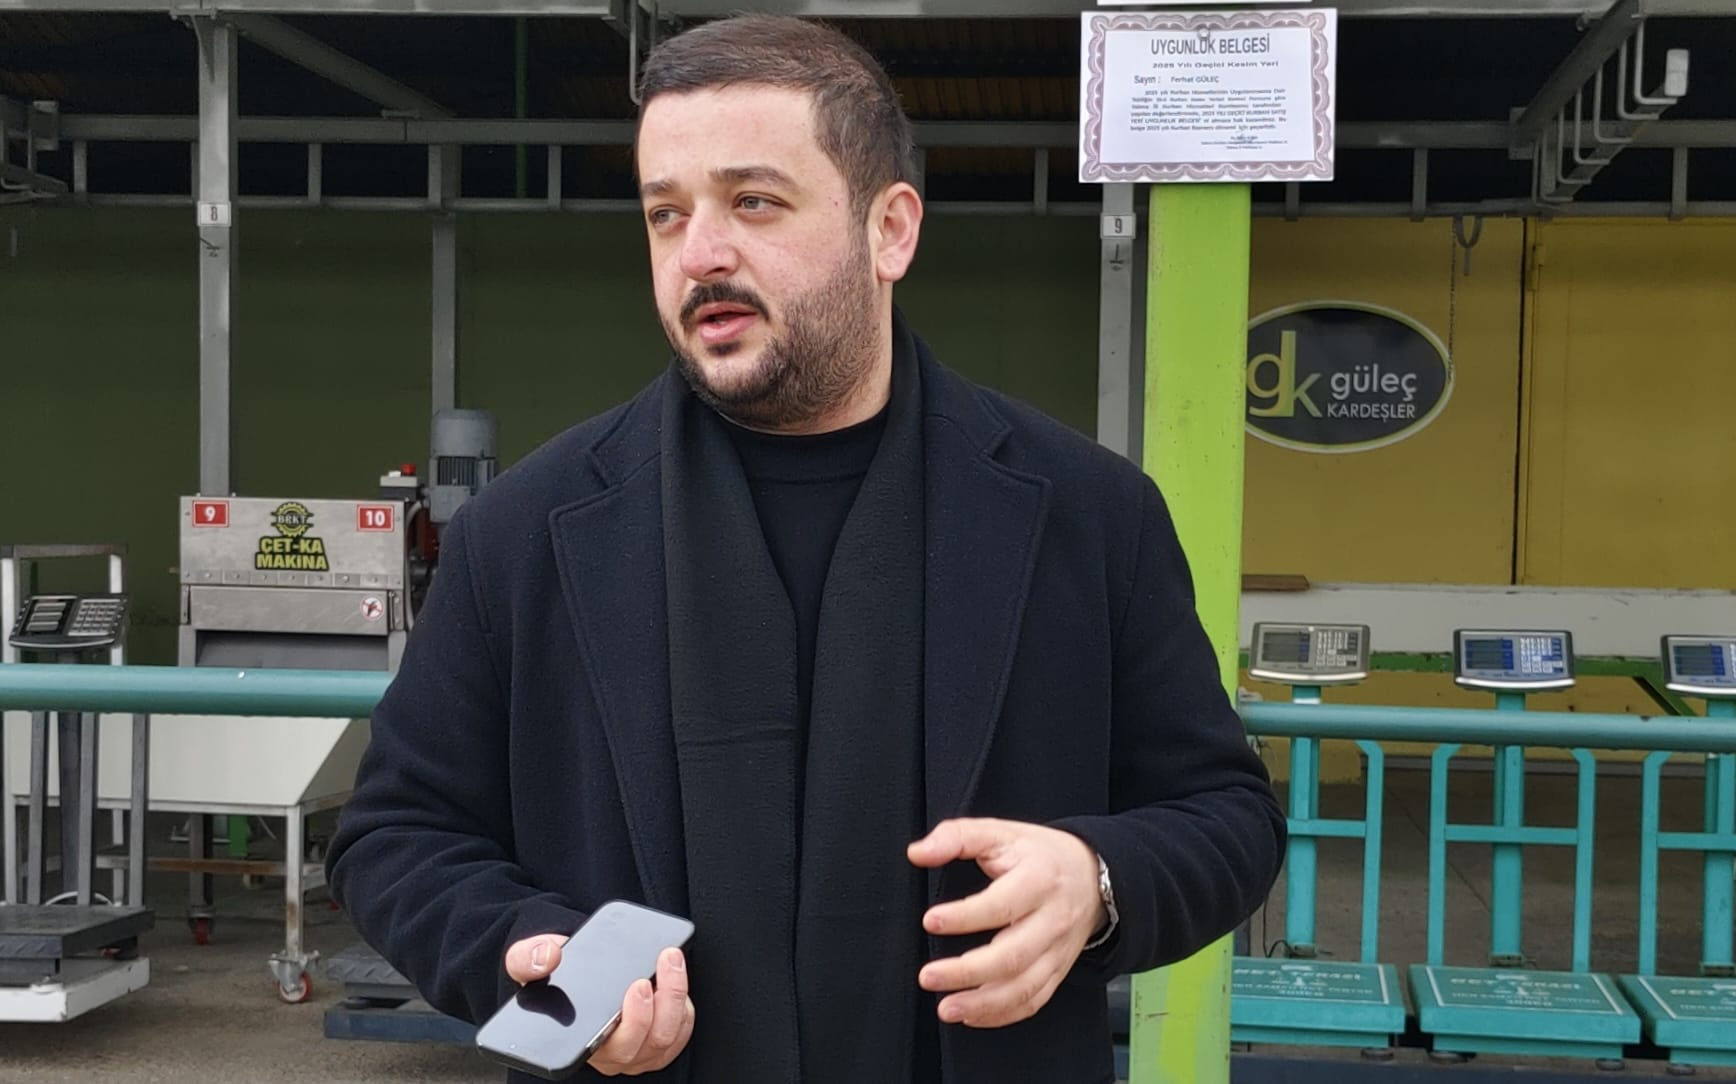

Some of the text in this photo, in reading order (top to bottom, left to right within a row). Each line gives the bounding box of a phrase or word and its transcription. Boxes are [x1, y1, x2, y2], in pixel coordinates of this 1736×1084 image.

[1219, 33, 1270, 54] BELGESİ
[1195, 61, 1225, 69] Geçici
[1134, 75, 1156, 86] Sayın
[1115, 217, 1122, 234] 9
[1331, 363, 1418, 402] güleç
[1327, 403, 1416, 423] KARDEŞLER
[205, 506, 216, 522] 9
[365, 510, 386, 527] 10
[261, 538, 323, 554] ÇET-KA
